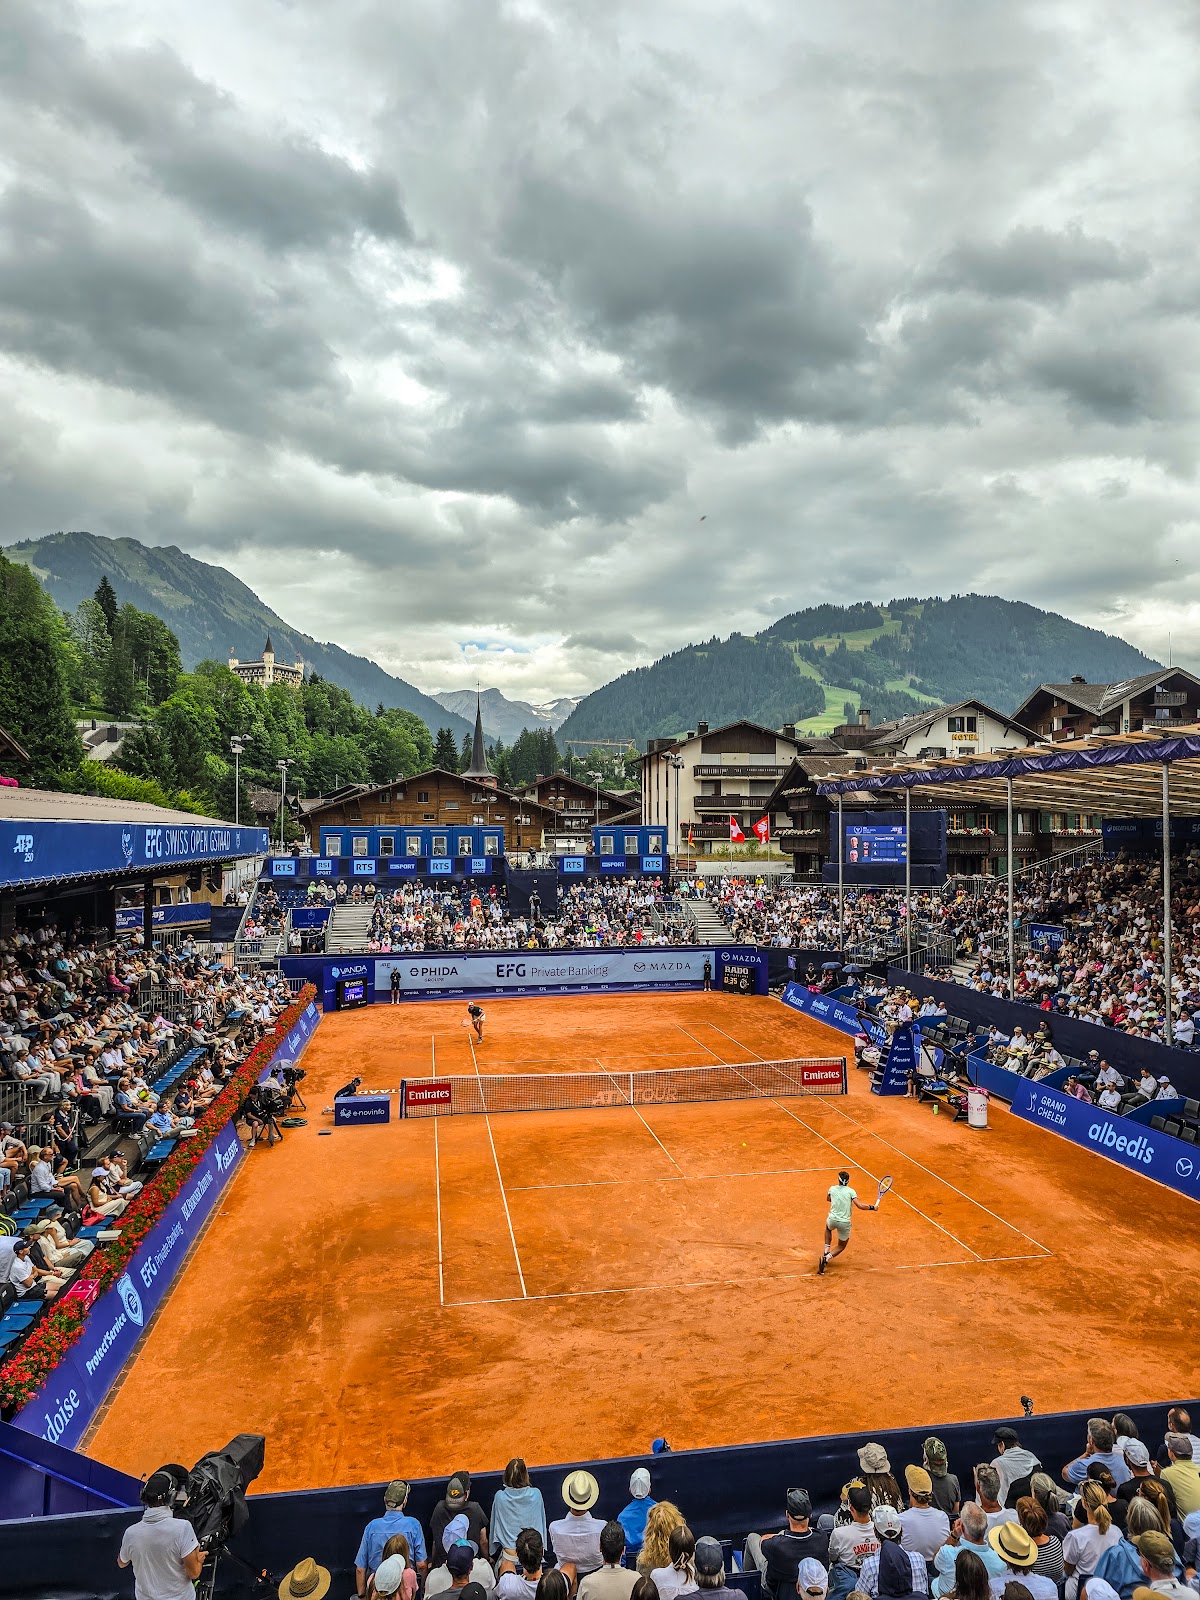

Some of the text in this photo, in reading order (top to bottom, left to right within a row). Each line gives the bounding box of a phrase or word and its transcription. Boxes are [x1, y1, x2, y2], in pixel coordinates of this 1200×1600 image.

[952, 733, 979, 741] HOTEL
[13, 834, 34, 853] ATP
[145, 828, 230, 858] EFG SWISS OPEN GSTAAD
[24, 852, 34, 862] 250
[276, 864, 292, 872] RTS
[356, 863, 373, 872] RTS
[433, 862, 450, 870] RTS
[732, 954, 761, 963] MAZDA
[496, 963, 608, 977] EFG Private Banking
[650, 962, 691, 970] MAZDA
[724, 966, 748, 974] RADO
[803, 1071, 840, 1080] Emirates
[408, 1090, 450, 1100] Emirates
[1041, 1096, 1066, 1112] GRAND
[353, 1108, 385, 1116] e-novinfo
[1038, 1107, 1066, 1126] CHELEM
[1088, 1122, 1155, 1164] albedis
[222, 1139, 238, 1169] CELESTE
[140, 1221, 184, 1288] EFG Private Banking
